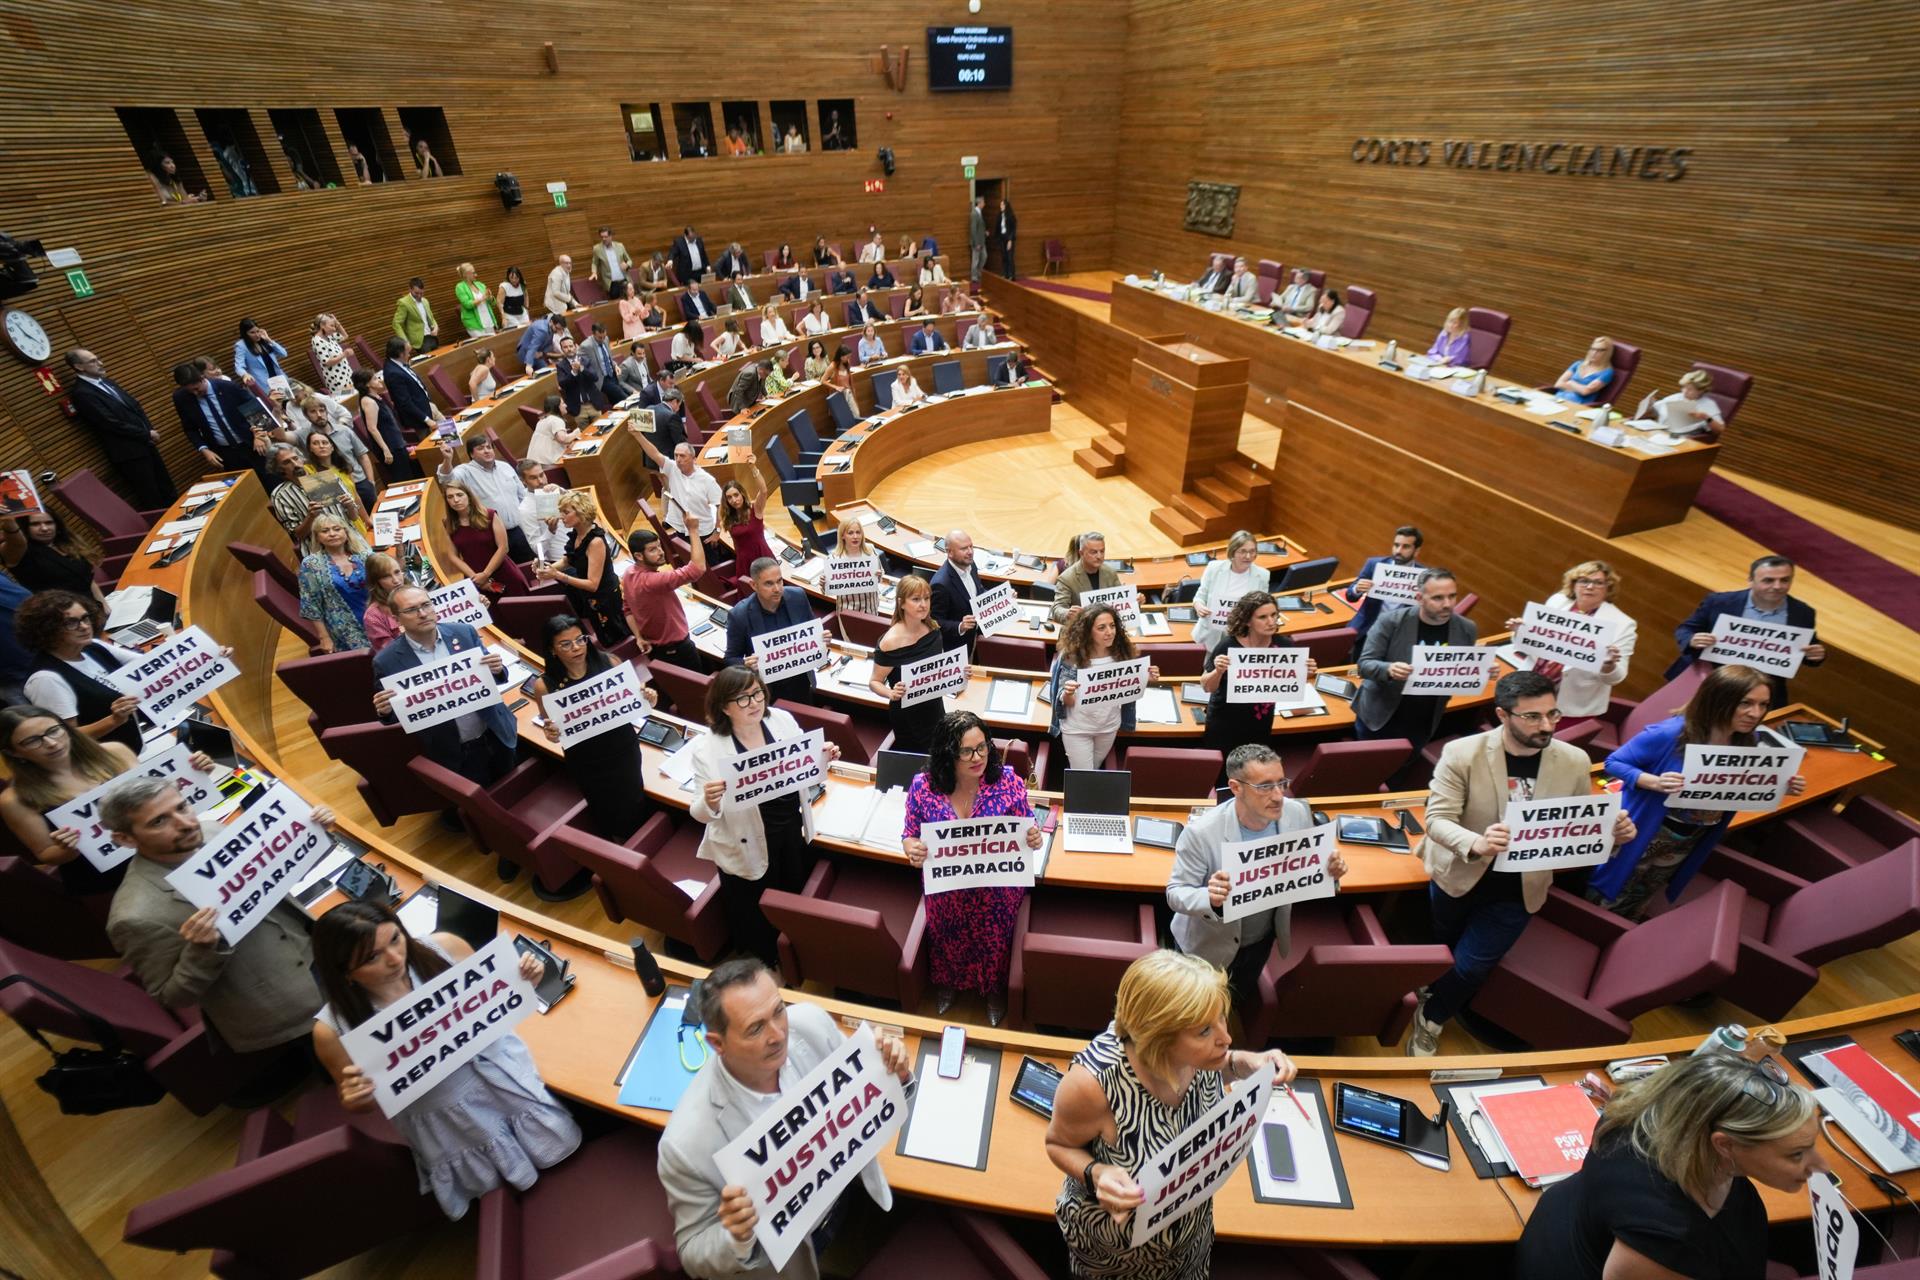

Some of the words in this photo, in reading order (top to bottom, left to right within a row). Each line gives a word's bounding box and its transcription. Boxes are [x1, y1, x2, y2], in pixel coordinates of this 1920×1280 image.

[958, 69, 985, 82] 00:10
[1352, 137, 1432, 166] CORTS
[1443, 139, 1693, 182] VALENCIANES
[831, 561, 871, 570] VERITAT
[831, 571, 872, 580] JUSTÍCIA
[1384, 570, 1418, 580] VERIT
[829, 580, 874, 590] REPARACIÓ
[1379, 582, 1418, 591] JUSTÍC
[430, 586, 466, 606] RITAT
[976, 588, 1007, 608] VERITAT
[1088, 590, 1129, 604] VERITAT
[980, 599, 1010, 620] JUSTÍCIA
[984, 608, 1017, 629] REPARACIÓ
[1536, 610, 1603, 636] VERITAT
[1729, 622, 1800, 641] VERITAT
[762, 627, 815, 648] VERITAT
[1529, 625, 1596, 650] JUSTÍCIA
[1720, 634, 1792, 654] JUSTÍCIA
[126, 636, 198, 682] VERITAT
[765, 640, 818, 662] JUSTÍCIA
[1238, 654, 1298, 664] VERITAT
[1424, 652, 1486, 661] VERITAT
[1523, 637, 1596, 663] REPARACIÓ
[1711, 647, 1791, 668] REPARACIÓ
[765, 652, 822, 675] REPARACIÓ
[910, 654, 960, 675] VERITAT
[1088, 665, 1142, 681] VERITAT
[1419, 666, 1480, 676] JUSTÍCIA
[143, 651, 214, 700] JUSTÍCIA
[396, 658, 473, 691] VERITAT
[909, 667, 961, 688] JUSTÍCIA
[1236, 670, 1296, 679] JUSTÍCIA
[1412, 679, 1480, 689] REPARACIÓ
[150, 662, 225, 714] REPARACIÓ
[404, 673, 482, 708] JUSTÍCIA
[555, 672, 626, 709] VERITAT
[907, 678, 963, 700] REPARACIÓ
[1085, 677, 1140, 694] JUSTÍCIA
[1234, 684, 1299, 693] REPARACIÓ
[407, 686, 491, 723] REPARACIÓ
[563, 688, 634, 724] JUSTÍCIA
[1081, 688, 1141, 705] REPARACIÓ
[565, 699, 642, 736] REPARACIÓ
[733, 739, 812, 771] VERITAT
[1700, 754, 1789, 767] VERITAT
[735, 755, 815, 788] JUSTÍCIA
[1691, 771, 1778, 785] JUSTÍCIA
[735, 766, 819, 802] REPARACIÓ
[1679, 789, 1775, 801] REPARACIÓ
[1522, 803, 1609, 822] VERITAT
[194, 799, 288, 880] VERITAT
[936, 822, 1020, 839] VERITAT
[1514, 823, 1602, 840] JUSTÍCIA
[934, 840, 1020, 858] JUSTÍCIA
[1238, 834, 1324, 864] VERITAT
[1508, 839, 1604, 861] REPARACIÓ
[218, 820, 306, 905] JUSTÍCIA
[932, 861, 1025, 879] REPARACIÓ
[1235, 854, 1320, 886] JUSTÍCIA
[228, 834, 318, 923] REPARACIÓ
[1231, 870, 1324, 907] REPARACIÓ
[370, 954, 499, 1043] VERITAT
[383, 978, 510, 1071] JUSTÍCIA
[391, 992, 522, 1095] REPARACIÓ
[743, 1049, 864, 1167] VERITAT
[1158, 1084, 1260, 1178] VERITAT
[1554, 1134, 1585, 1148] PSPV
[763, 1081, 882, 1205] JUSTÍCIA
[769, 1100, 896, 1237] REPARACIÓ
[1154, 1113, 1257, 1206] JUSTÍCIA
